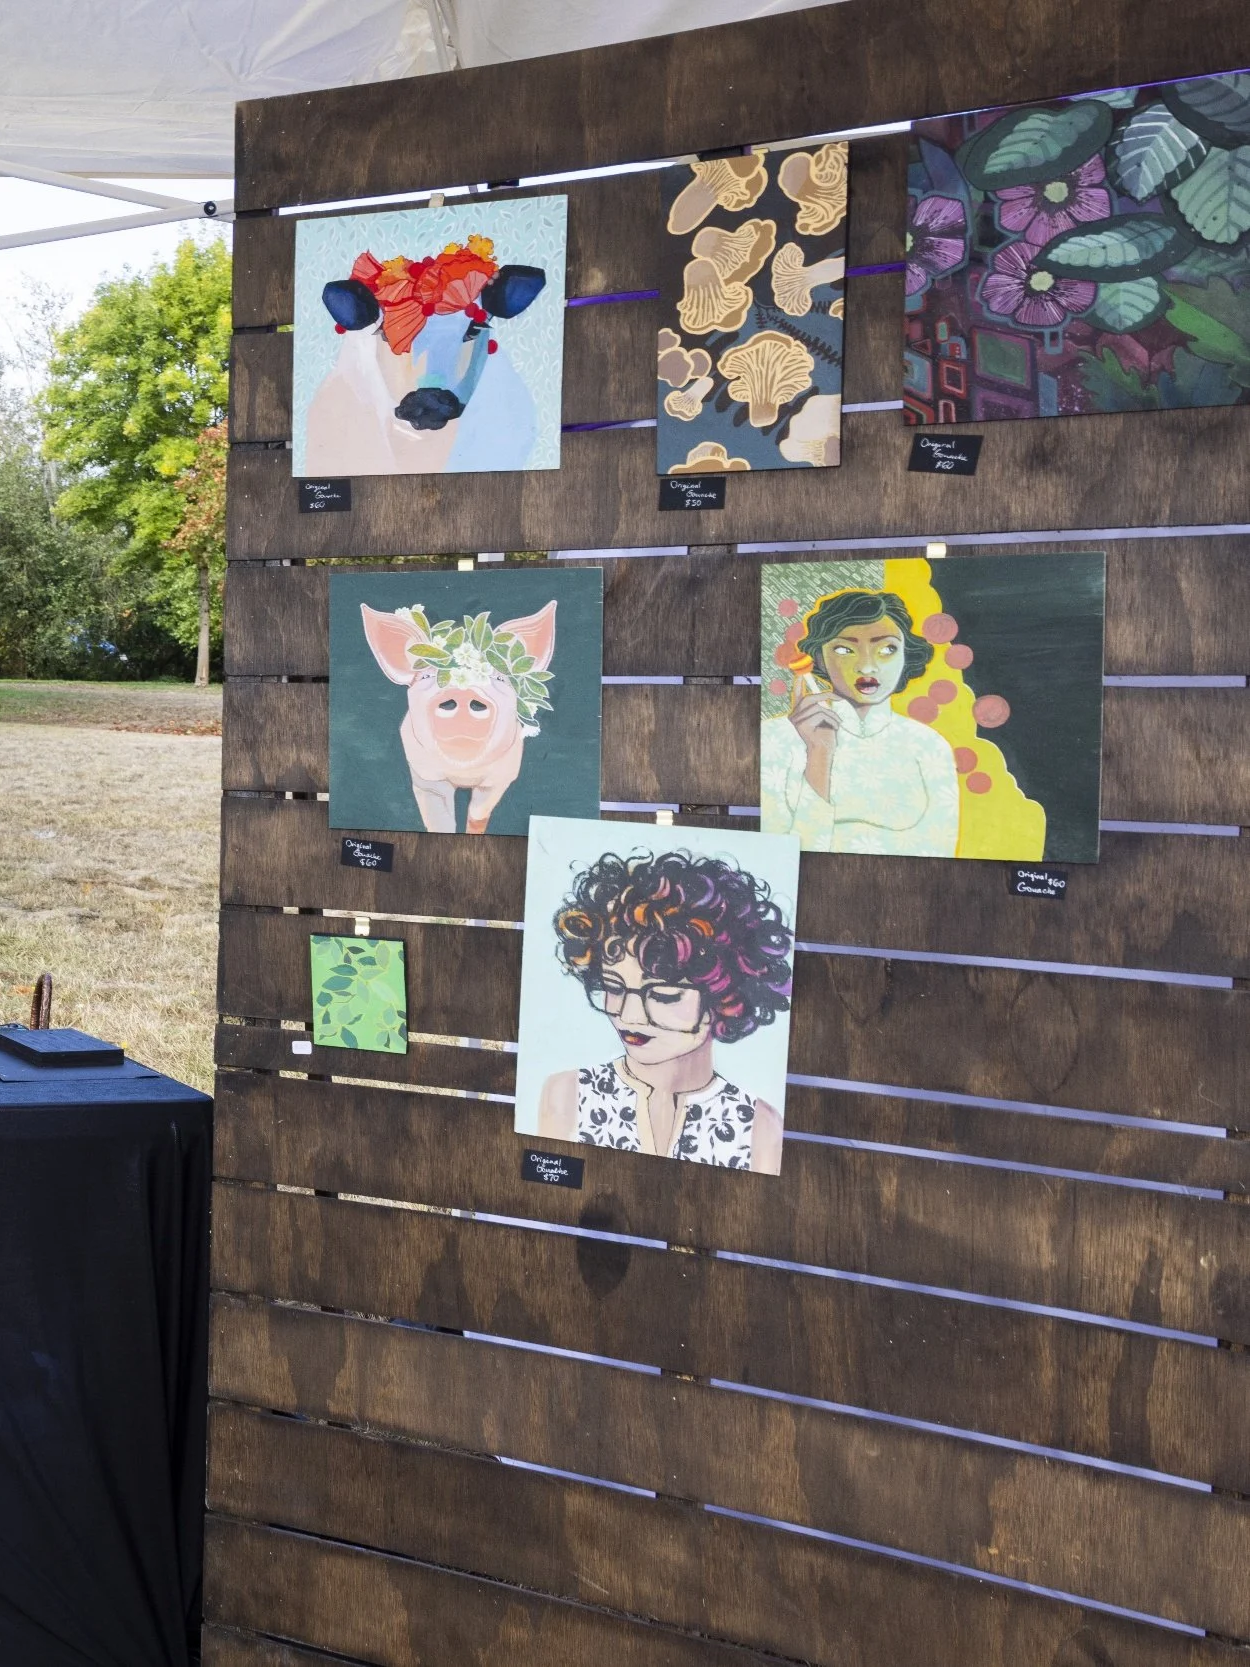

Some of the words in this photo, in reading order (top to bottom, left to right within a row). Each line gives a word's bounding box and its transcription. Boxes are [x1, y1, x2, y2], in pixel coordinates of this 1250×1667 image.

[920, 438, 955, 450] Original
[305, 484, 330, 492] Original
[670, 481, 701, 491] Original
[346, 840, 371, 850] Original
[1017, 870, 1048, 881] Original
[1048, 878, 1066, 888] $60
[1017, 882, 1056, 895] Gouache
[530, 1155, 561, 1167] Original
[544, 1174, 559, 1182] $70
